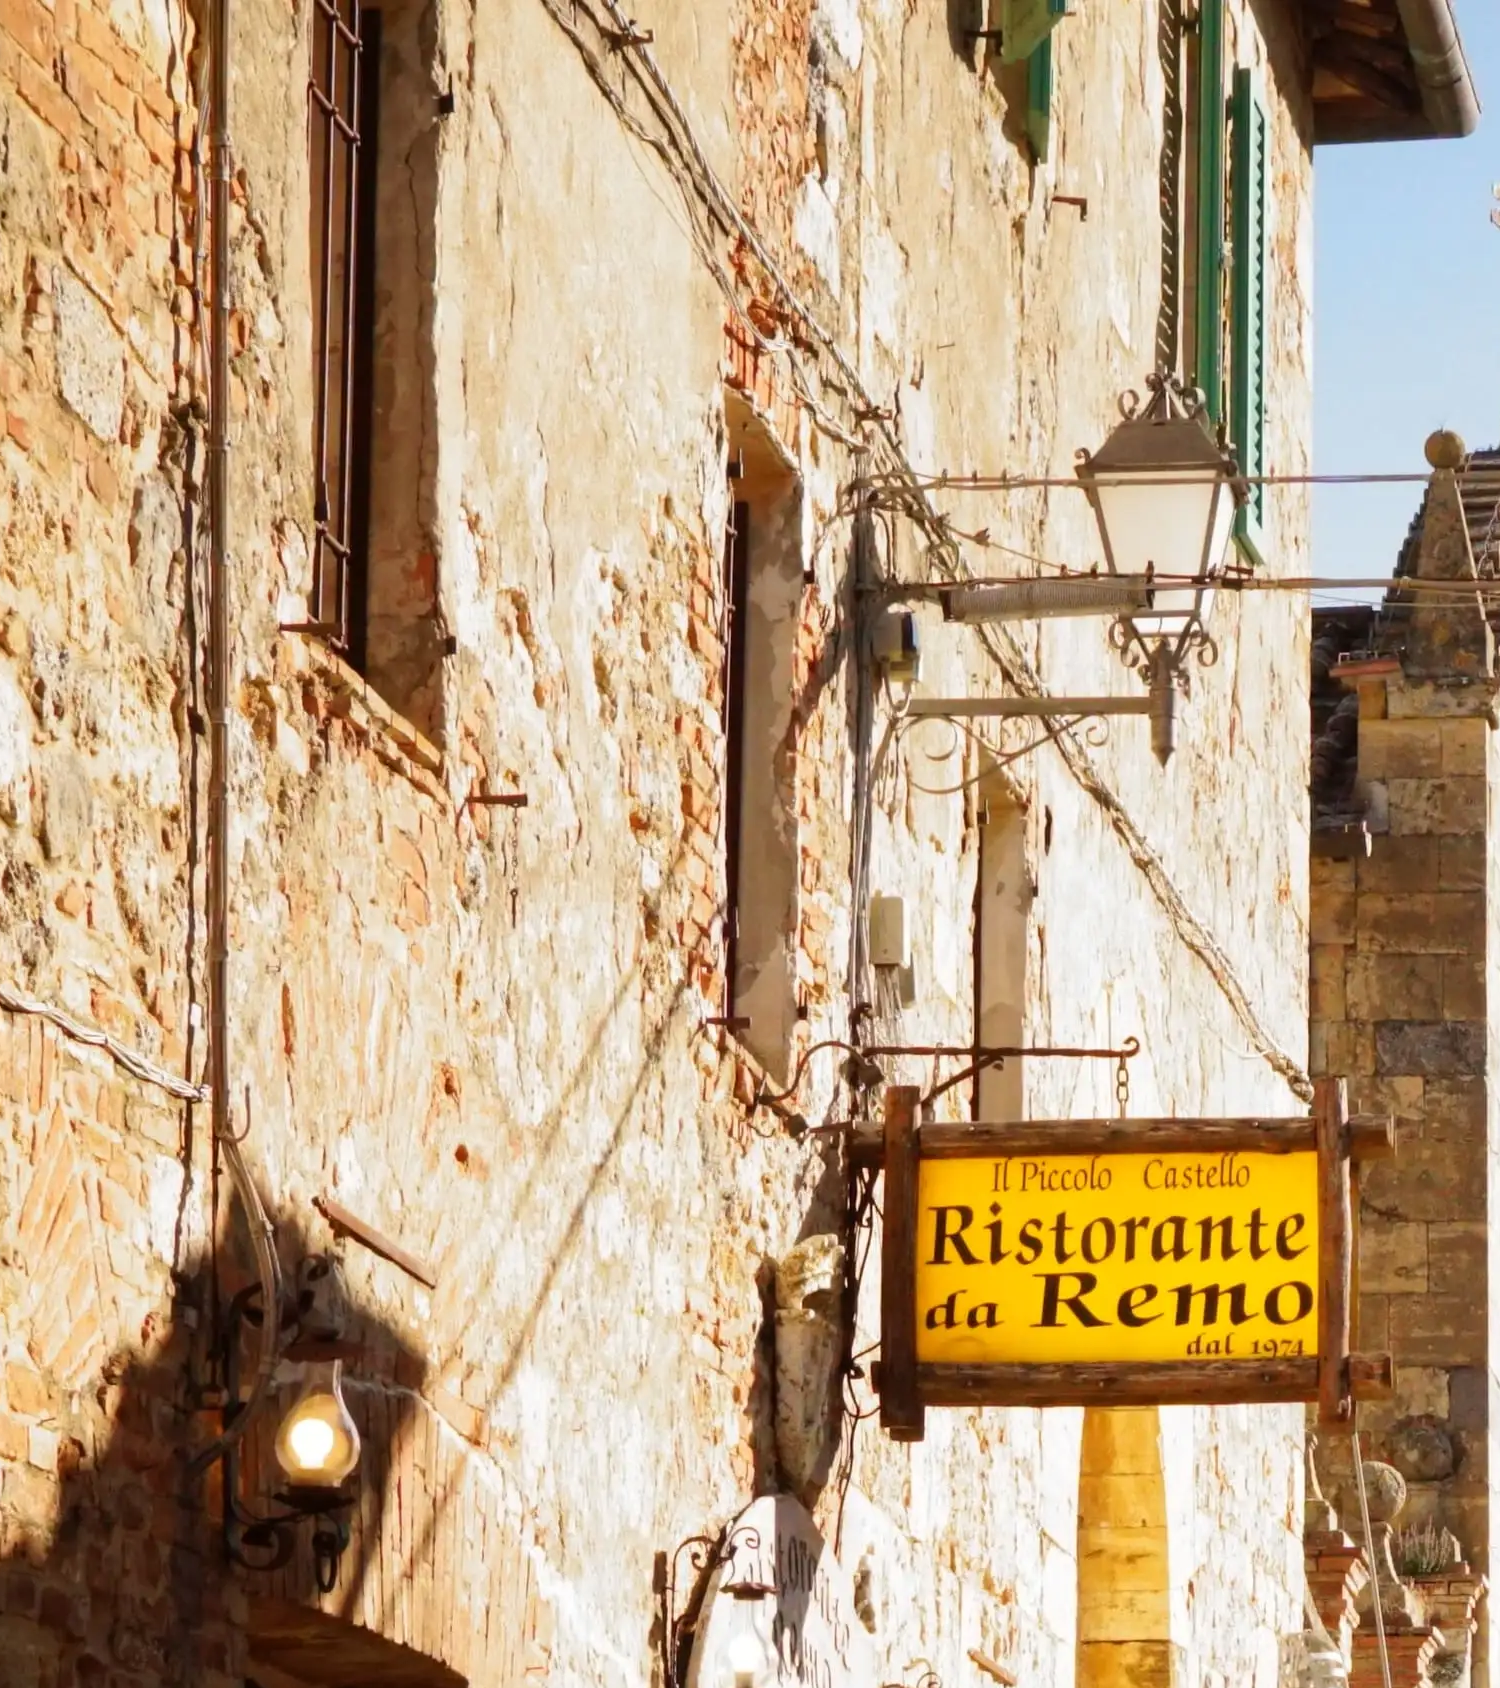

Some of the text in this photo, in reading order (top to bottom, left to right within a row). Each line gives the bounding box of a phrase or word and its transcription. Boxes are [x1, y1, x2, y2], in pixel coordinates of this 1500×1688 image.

[991, 1152, 1251, 1192] Il Piccolo Castello
[925, 1201, 1311, 1266] Ristorante
[925, 1271, 1313, 1330] da Remo
[1186, 1331, 1305, 1358] dal 1974
